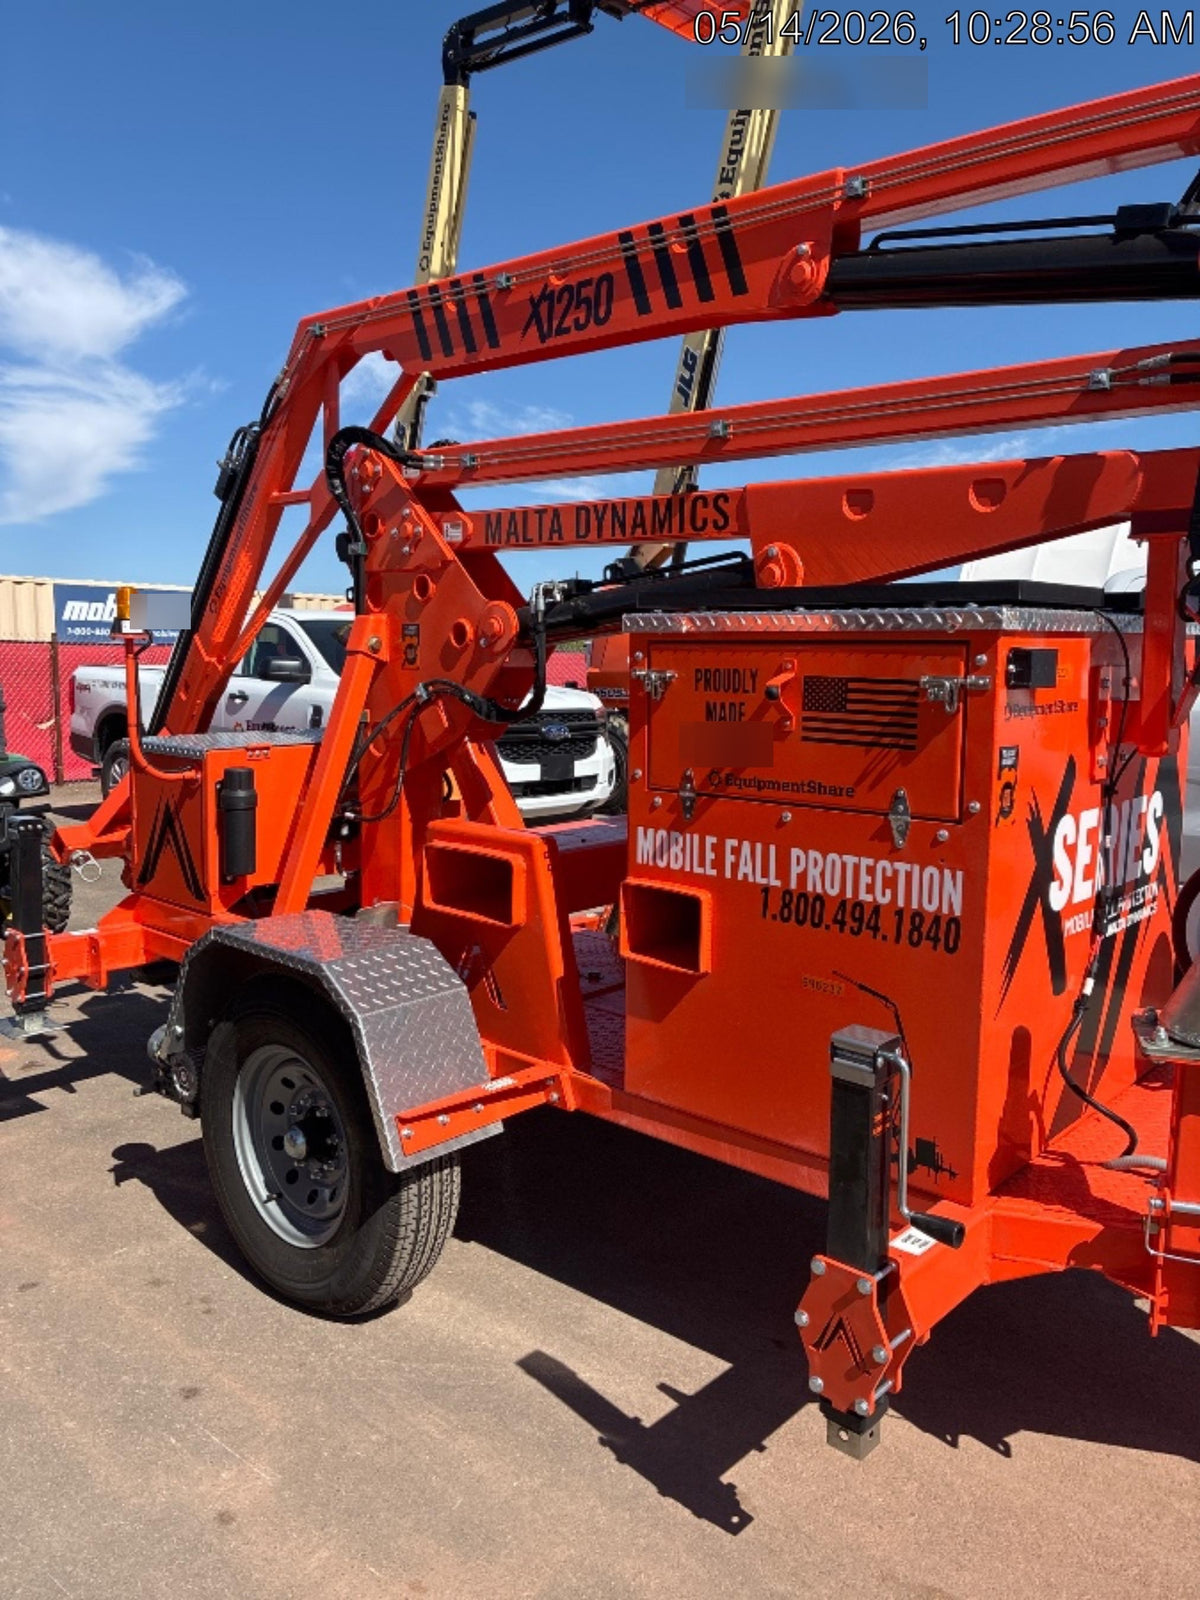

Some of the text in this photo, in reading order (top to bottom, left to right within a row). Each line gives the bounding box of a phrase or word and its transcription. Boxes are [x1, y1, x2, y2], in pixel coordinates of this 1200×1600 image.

[520, 271, 615, 344] X1250
[676, 345, 699, 408] JLG
[484, 509, 564, 545] MALTA
[575, 493, 730, 541] DYNAMICS
[694, 668, 759, 695] PROUDLY
[724, 773, 856, 798] EquipmentShare
[635, 827, 965, 917] MOBILE FALL PROTECTION
[759, 886, 962, 955] 1.800.494.1840
